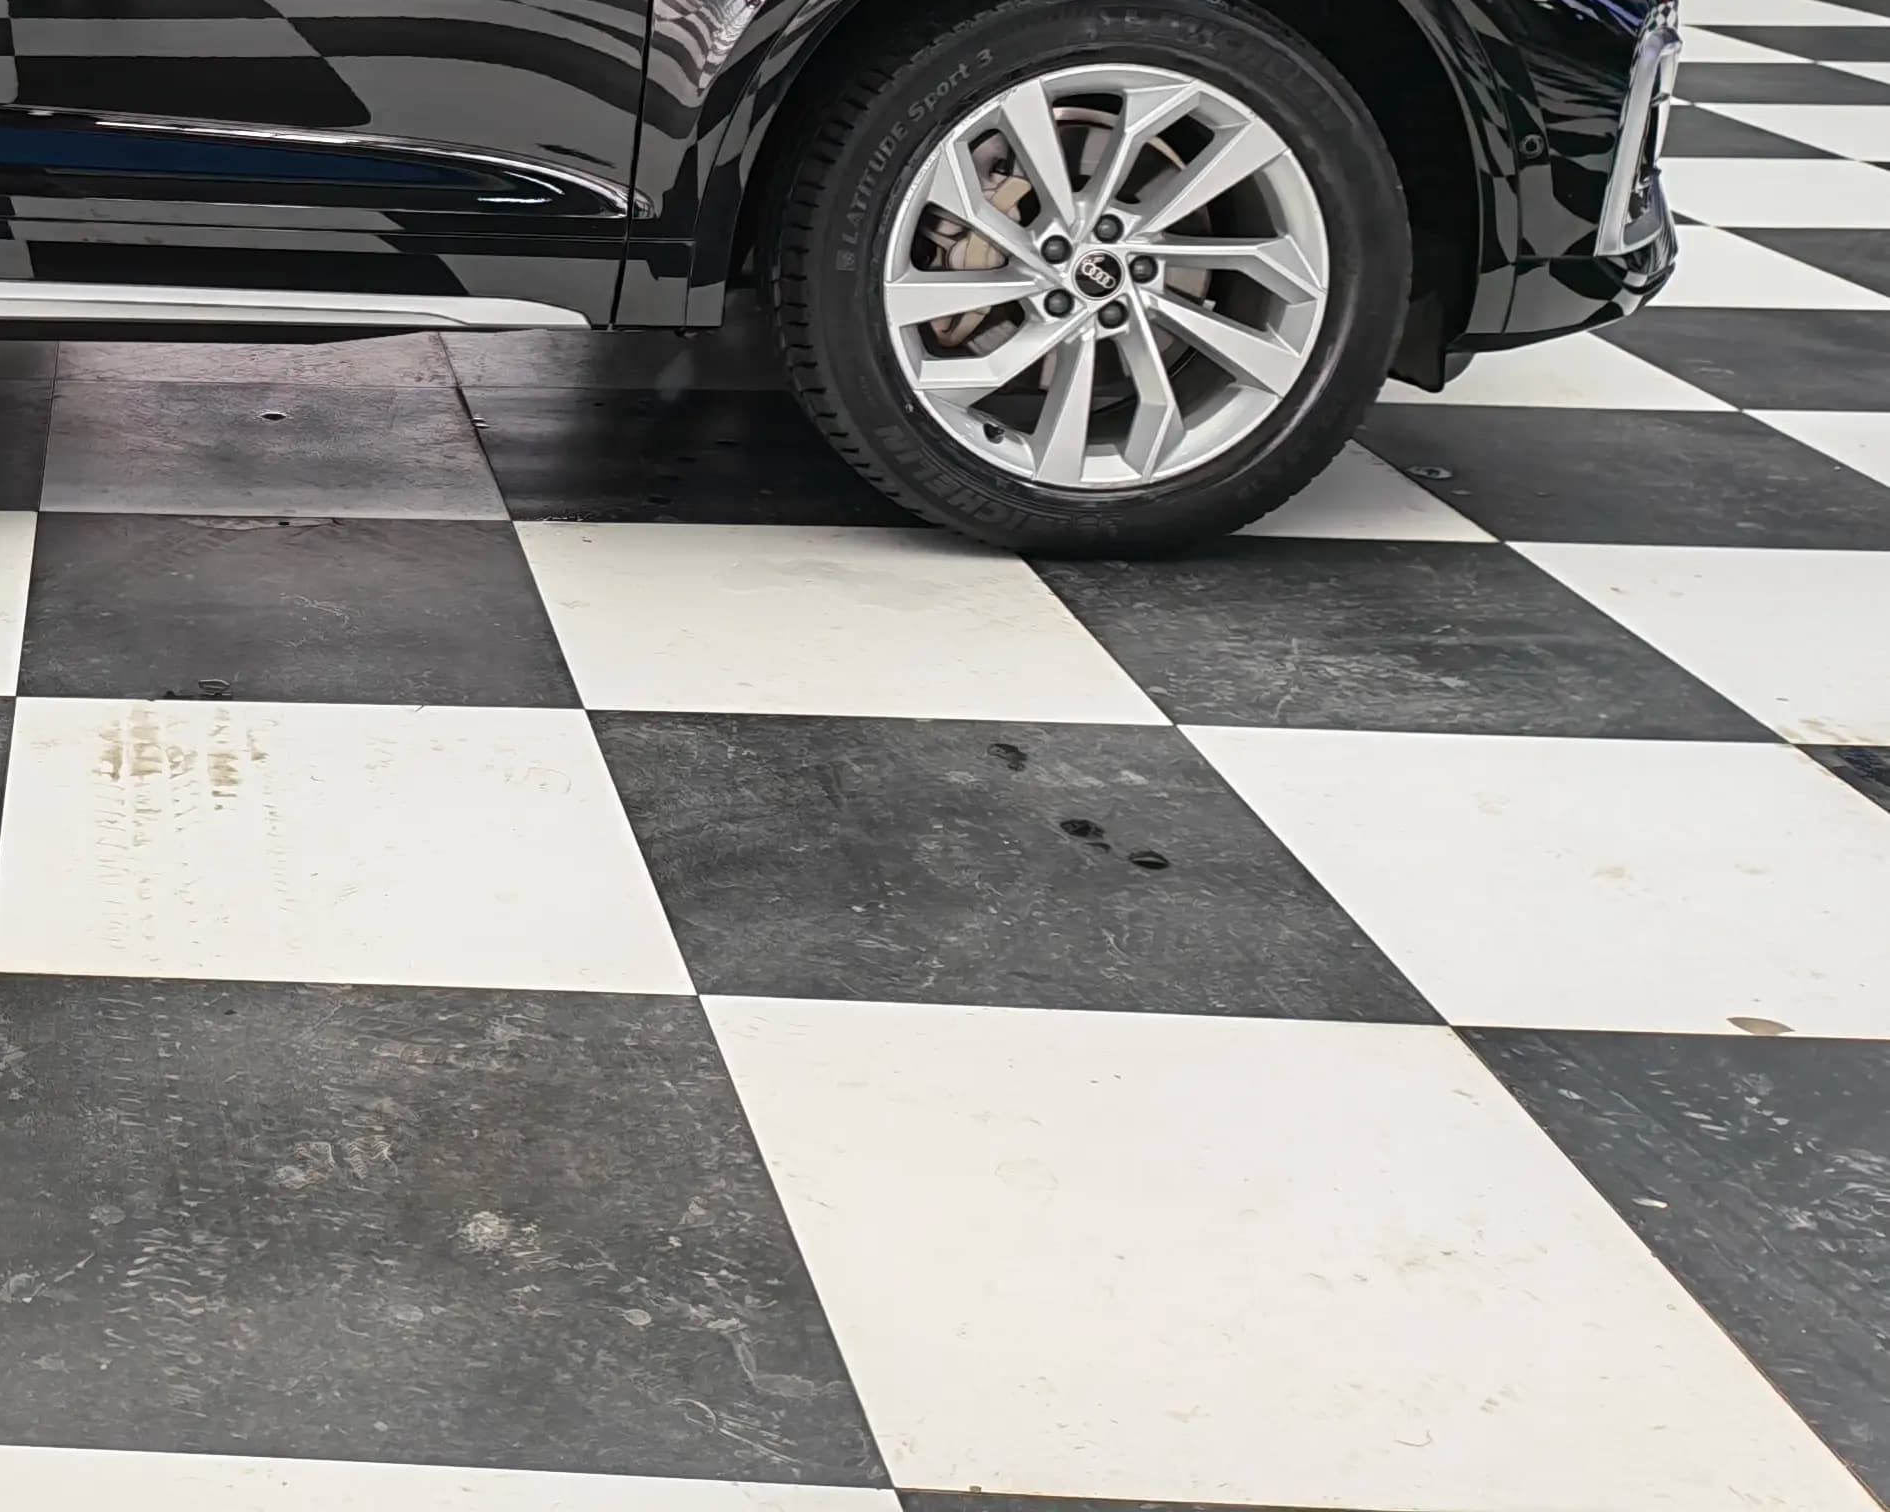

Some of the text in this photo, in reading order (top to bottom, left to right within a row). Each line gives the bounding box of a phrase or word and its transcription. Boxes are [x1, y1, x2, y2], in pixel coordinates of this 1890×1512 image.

[842, 47, 994, 246] LATITUDE Sport 3
